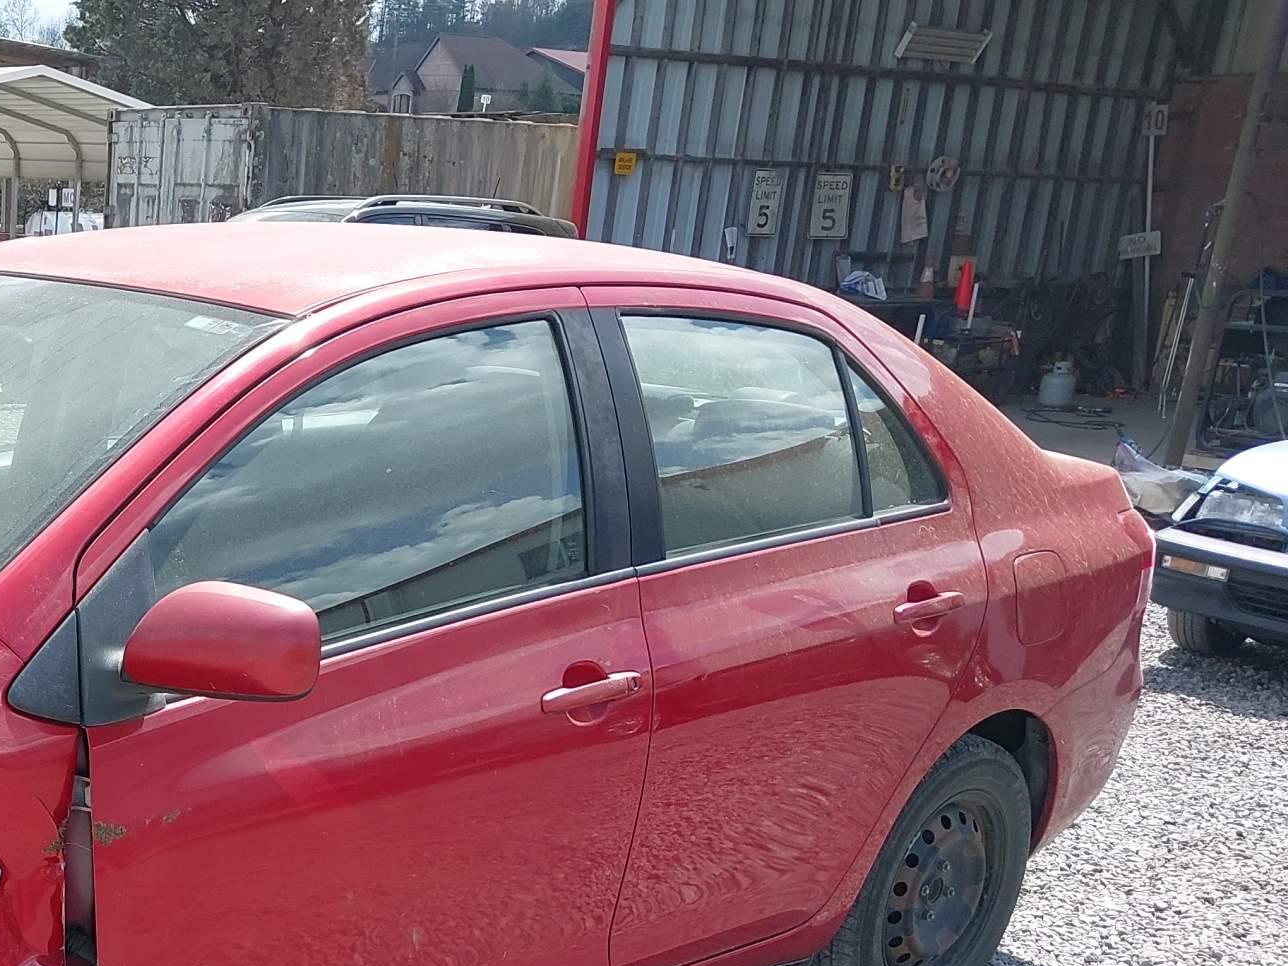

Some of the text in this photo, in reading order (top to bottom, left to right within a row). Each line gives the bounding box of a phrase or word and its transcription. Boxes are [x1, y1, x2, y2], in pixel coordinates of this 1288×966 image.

[1145, 110, 1166, 130] 10
[755, 176, 783, 186] SPEED
[816, 180, 849, 191] SPEED
[755, 191, 777, 201] LIMIT
[817, 194, 843, 205] LIMIT
[756, 205, 770, 229] 5
[821, 208, 837, 232] 5
